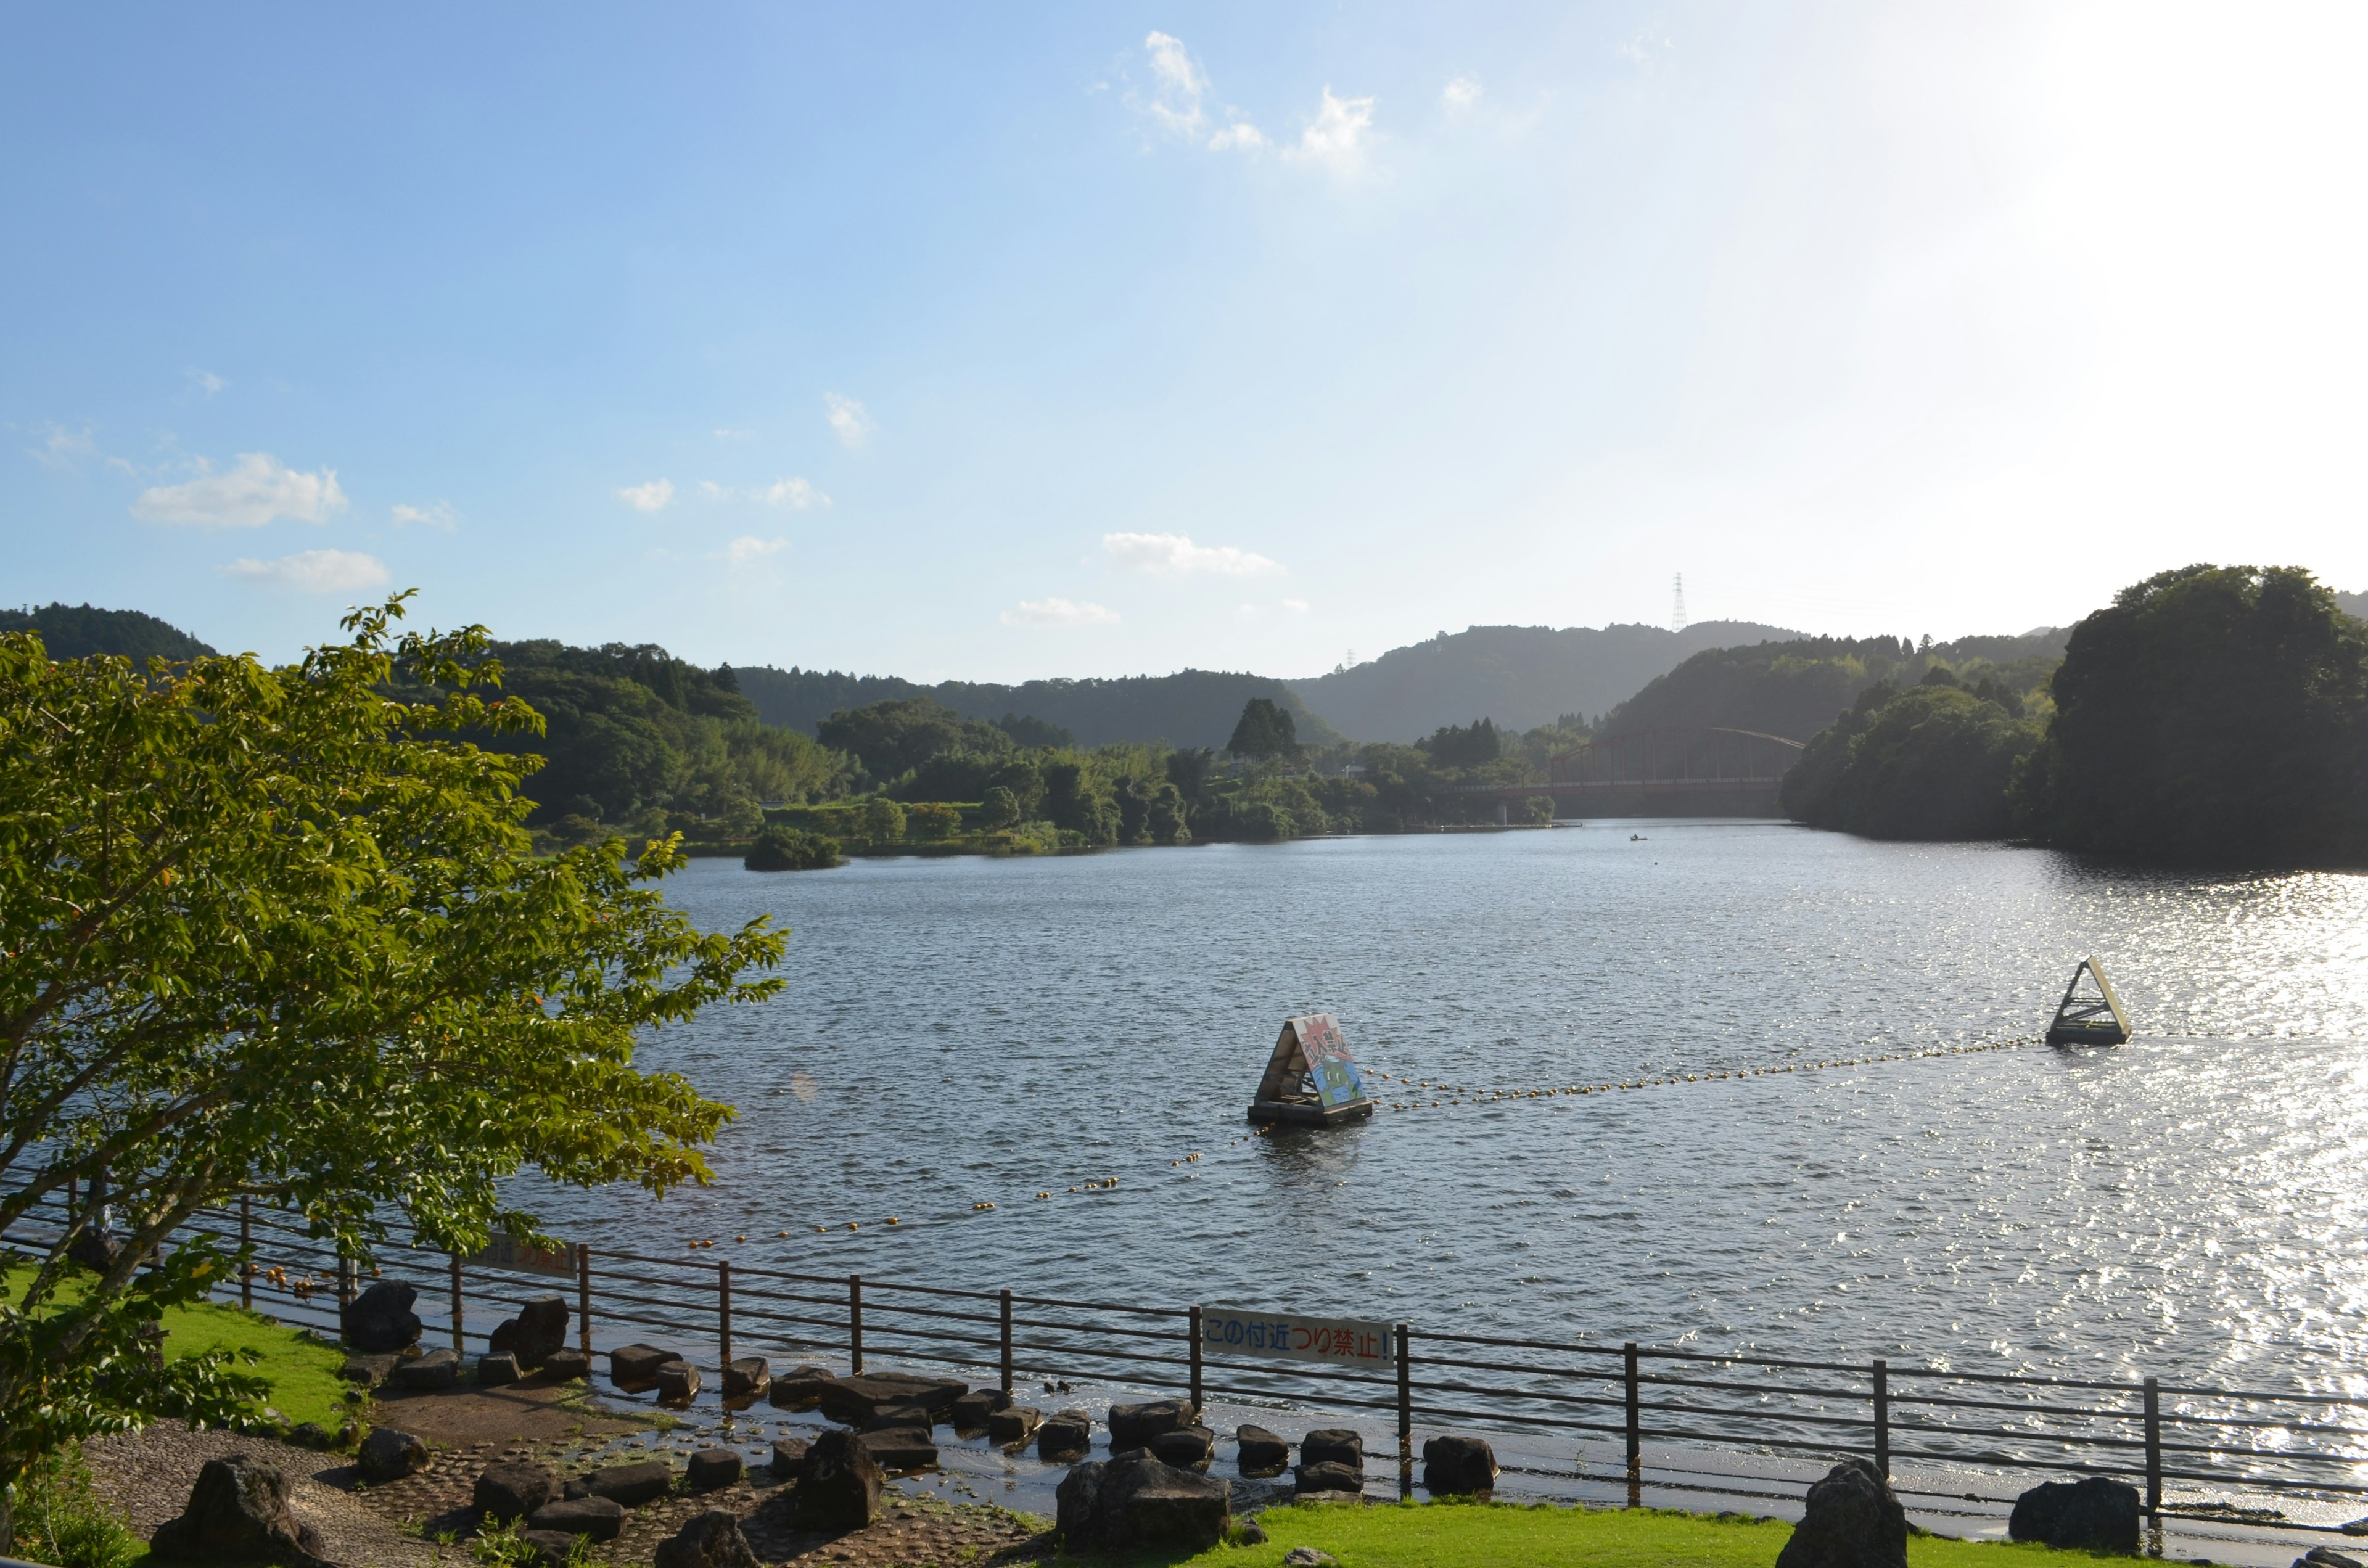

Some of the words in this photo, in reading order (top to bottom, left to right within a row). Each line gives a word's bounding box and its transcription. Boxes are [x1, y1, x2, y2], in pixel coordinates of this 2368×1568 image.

[1304, 1030, 1349, 1065] 立入禁止
[1206, 1318, 1388, 1360] この付近つり禁止!
